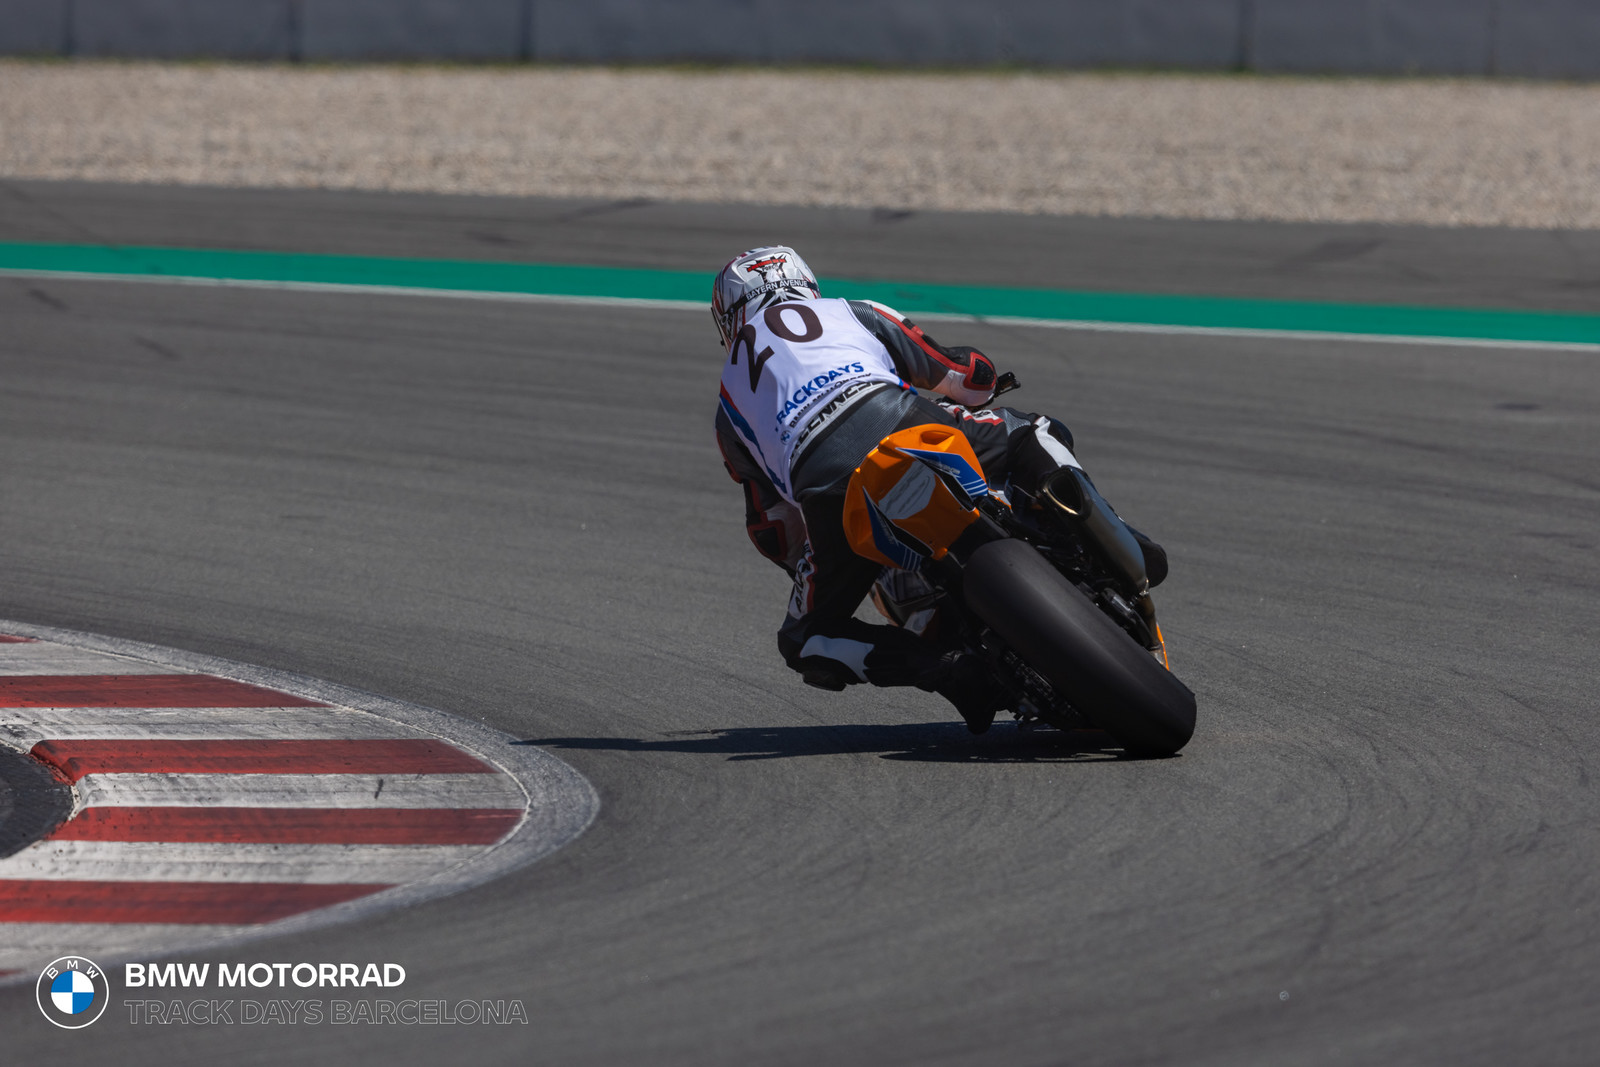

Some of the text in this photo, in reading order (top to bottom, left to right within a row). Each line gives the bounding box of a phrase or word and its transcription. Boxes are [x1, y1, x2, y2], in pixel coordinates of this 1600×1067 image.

[746, 279, 808, 299] BAYERN AVENUE
[731, 303, 823, 394] 20
[775, 362, 864, 432] RACKDAYS
